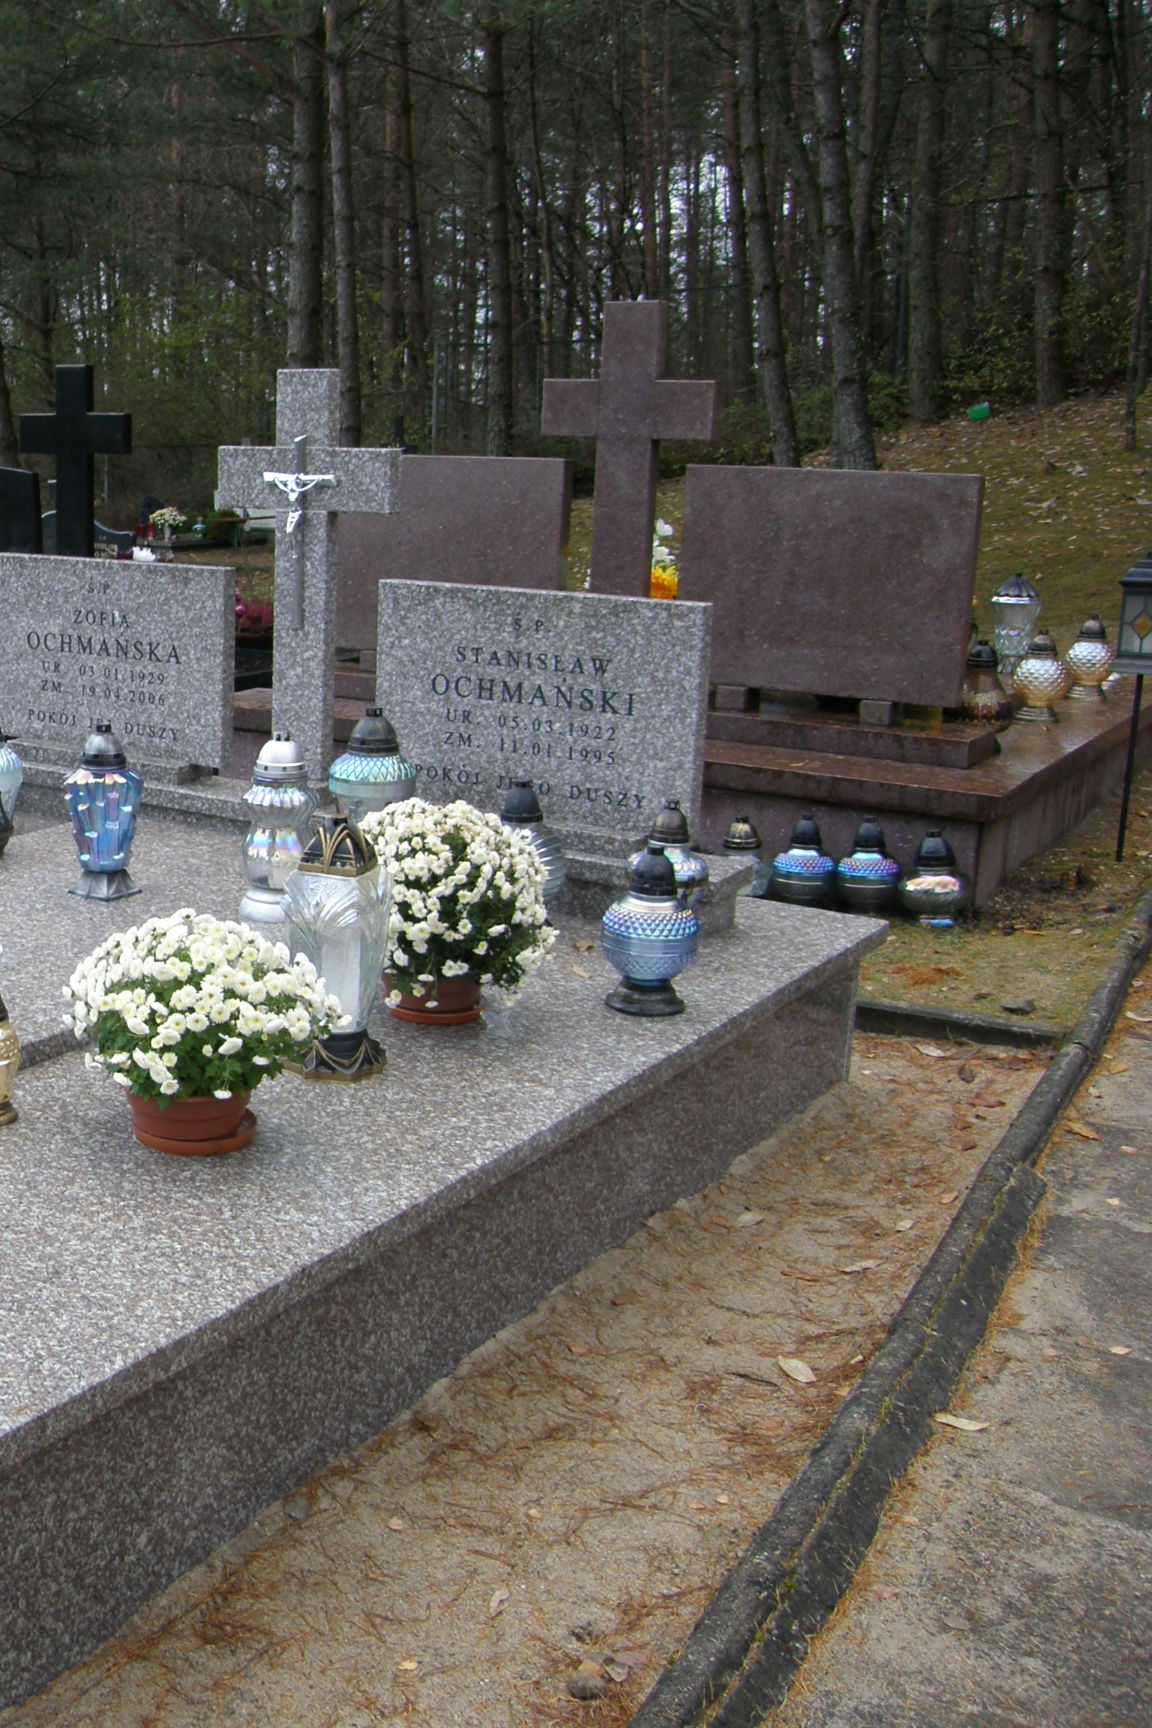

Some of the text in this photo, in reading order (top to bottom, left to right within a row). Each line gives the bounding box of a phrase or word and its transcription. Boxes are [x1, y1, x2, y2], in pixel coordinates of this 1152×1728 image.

[72, 608, 130, 628] ZOFIA
[27, 631, 182, 665] OCHMAŃSKA
[455, 646, 612, 677] STANISŁAW
[430, 673, 635, 717] OCHMAŃSKI
[124, 722, 180, 742] DUSZY
[446, 708, 616, 742] UR. 05.03.1922
[444, 731, 616, 766] ZM. 11.01.1995
[414, 763, 481, 786] POKÓJ
[569, 785, 647, 810] DUSZY
